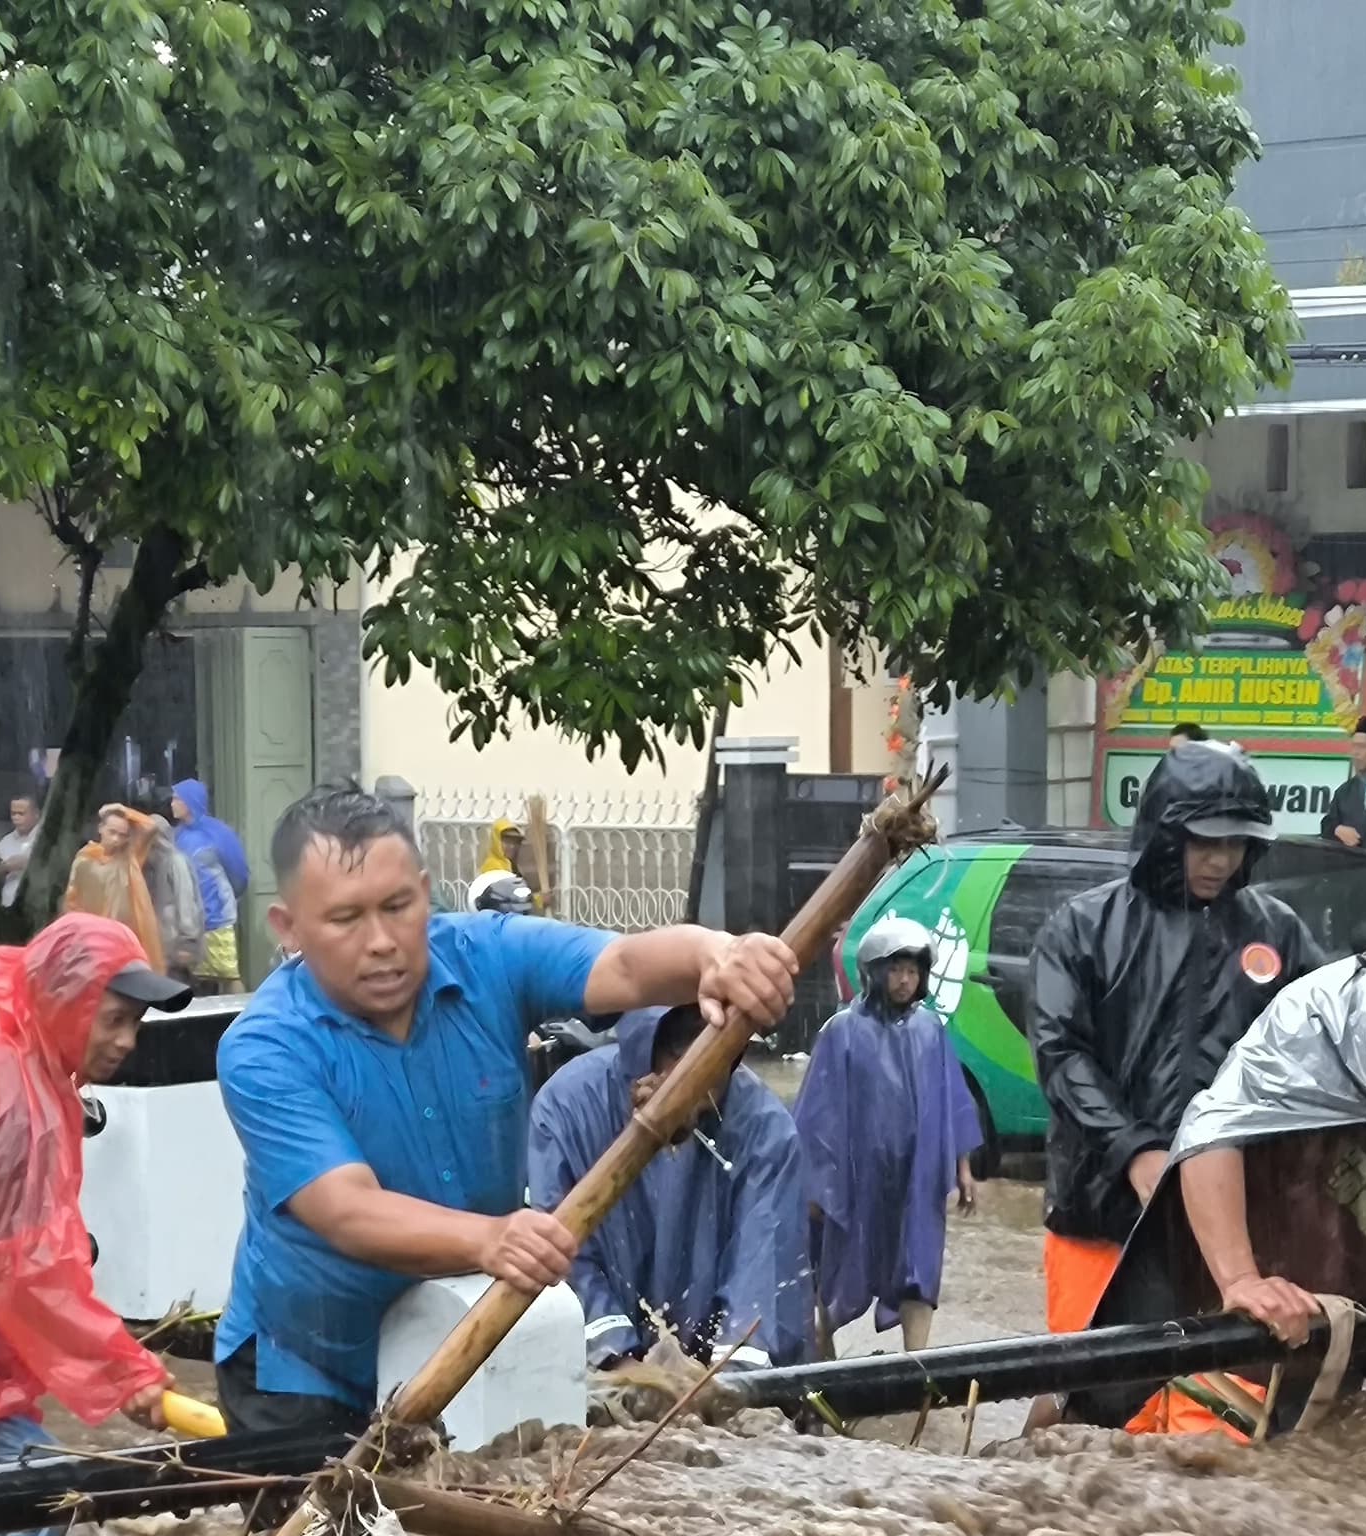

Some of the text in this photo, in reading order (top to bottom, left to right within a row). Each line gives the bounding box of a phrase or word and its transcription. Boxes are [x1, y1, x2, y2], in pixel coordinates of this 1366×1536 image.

[1154, 657, 1309, 676] ATAS TERPILIHNYA
[1142, 678, 1321, 706] Bp. AMIR HUSEIN
